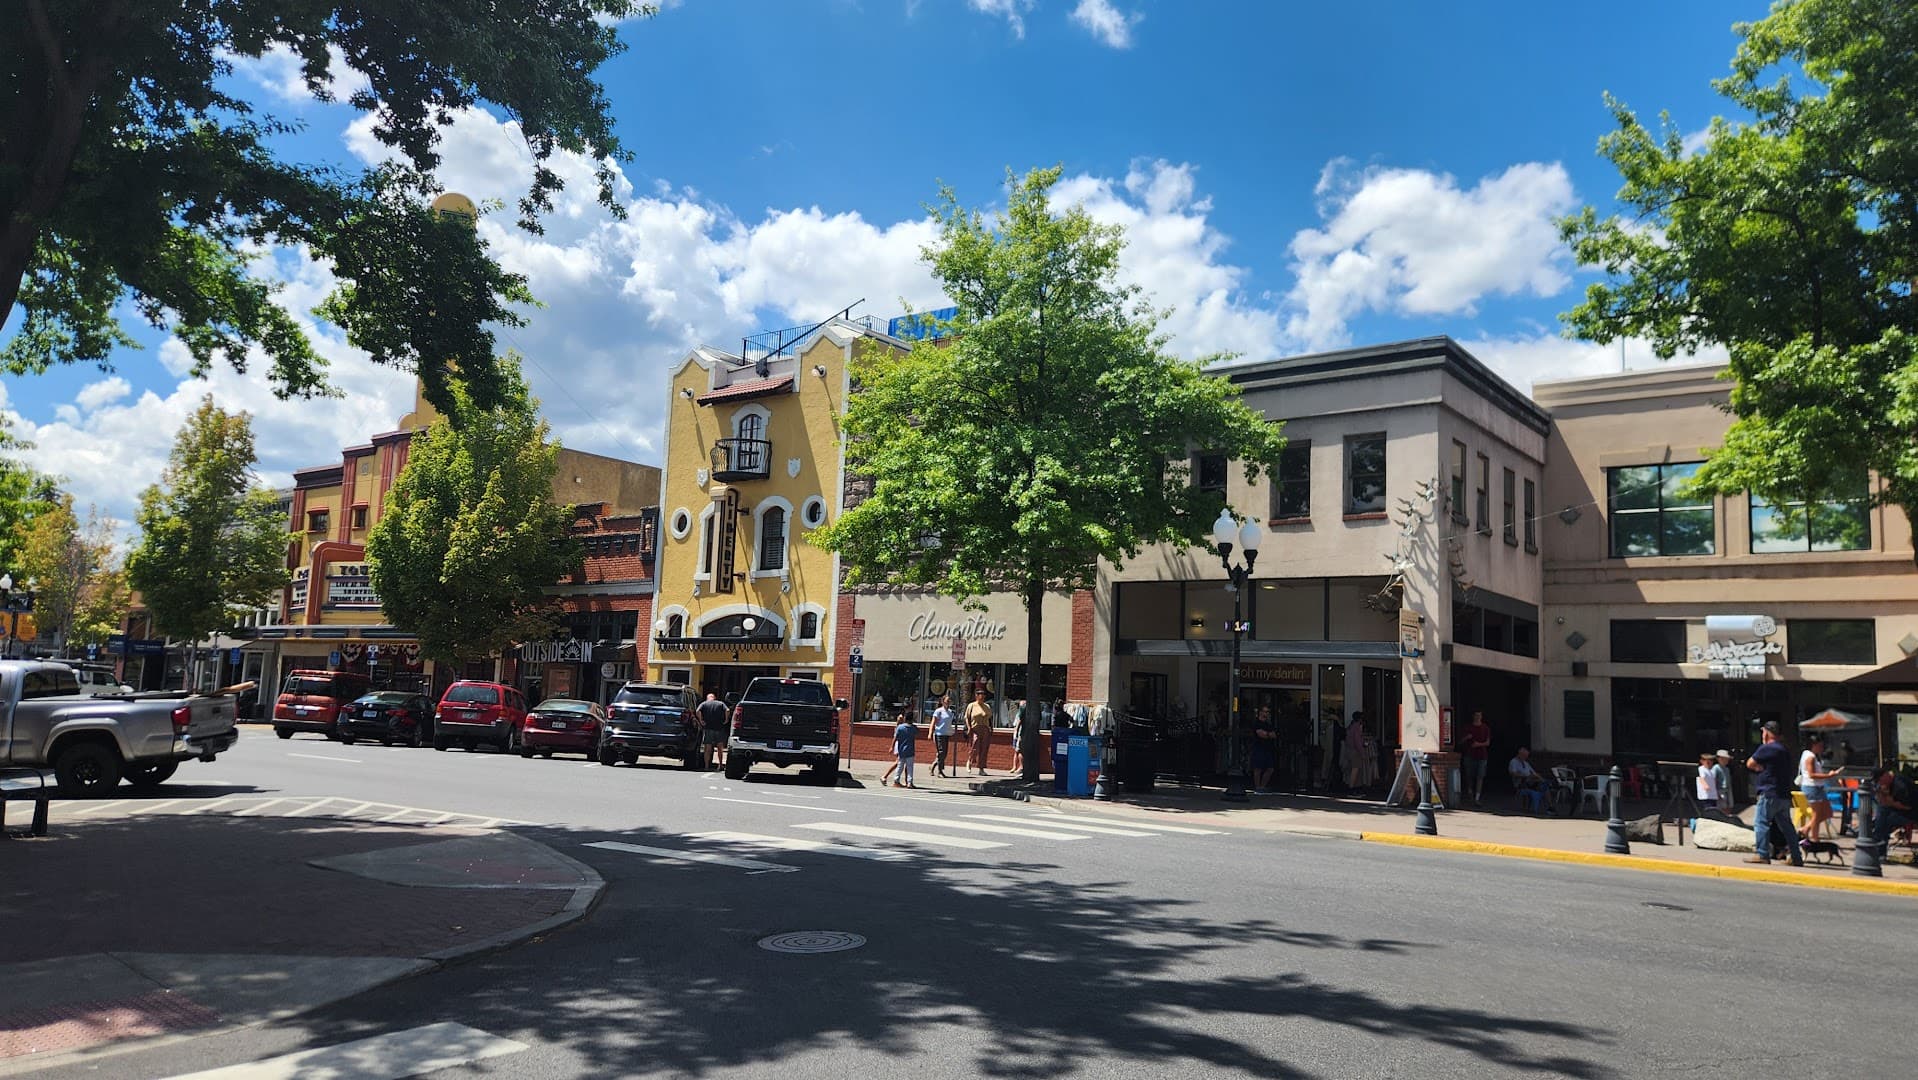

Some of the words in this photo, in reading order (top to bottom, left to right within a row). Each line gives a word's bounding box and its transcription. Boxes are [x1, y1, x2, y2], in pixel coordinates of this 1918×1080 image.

[723, 496, 735, 589] LIBERTY
[909, 609, 1006, 641] Clementine
[521, 641, 565, 662] OUTSIDE
[580, 641, 593, 663] IN
[1240, 665, 1254, 679] oh
[1256, 667, 1272, 681] my
